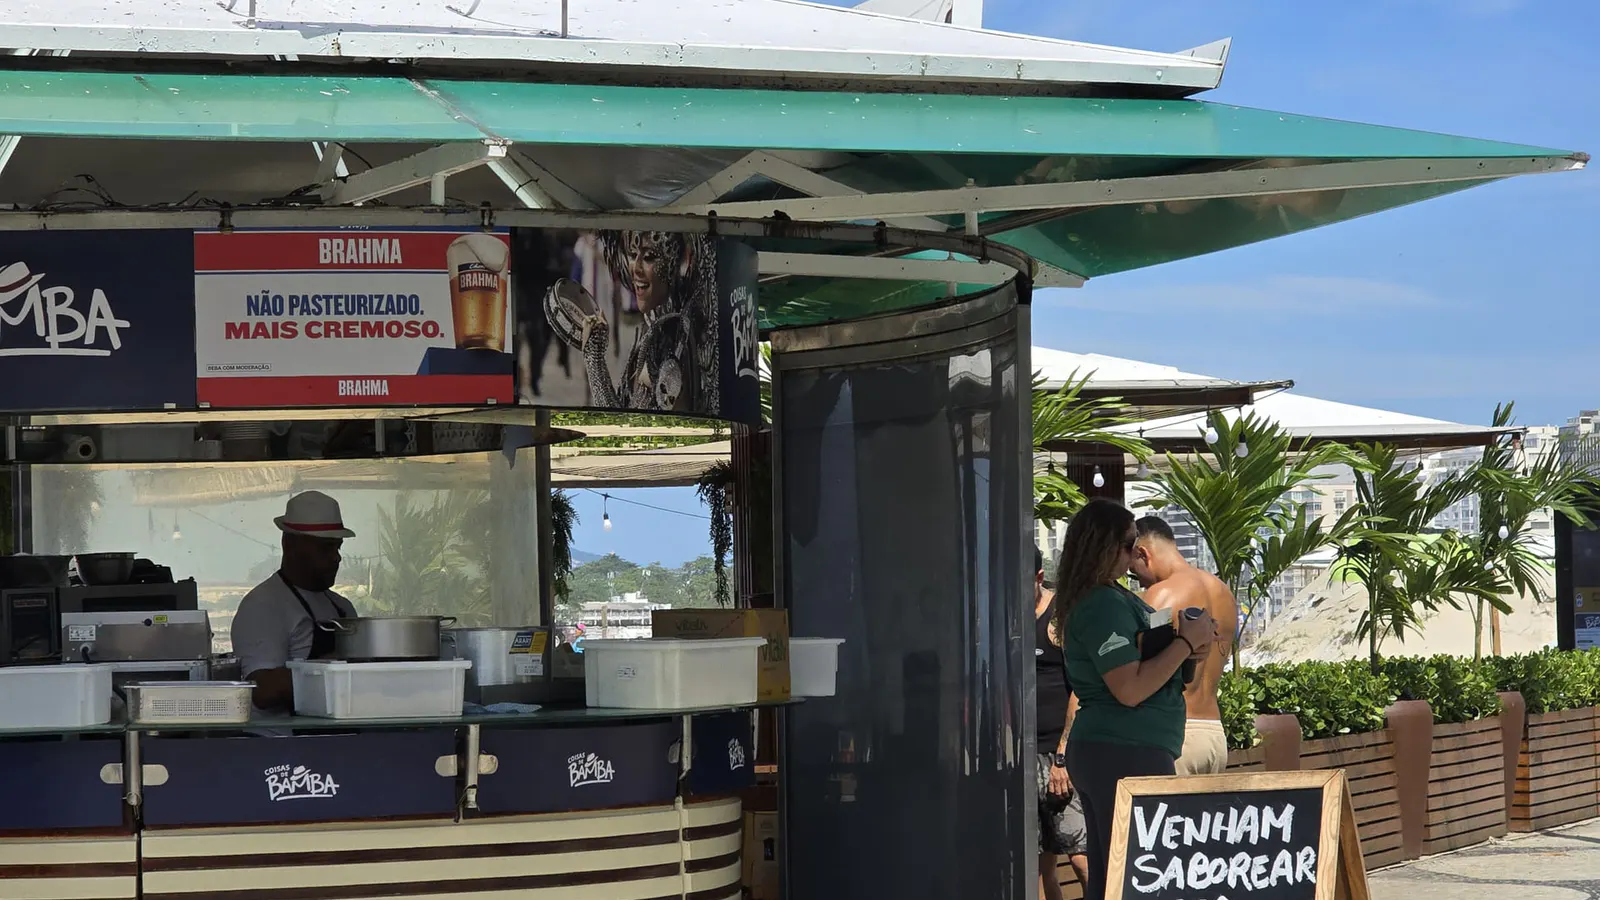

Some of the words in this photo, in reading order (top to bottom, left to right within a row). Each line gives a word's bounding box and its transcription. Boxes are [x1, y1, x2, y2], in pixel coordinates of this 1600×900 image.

[318, 238, 403, 265] BRAHMA
[460, 272, 498, 288] BRAHMA
[246, 290, 284, 316] NÃO
[288, 294, 425, 316] PASTEURIZADO.
[730, 286, 747, 307] COISAS
[225, 321, 299, 340] MAIS
[304, 320, 445, 338] CREMOSO.
[338, 379, 389, 396] BRAHMA
[264, 764, 291, 776] COISAS
[568, 760, 615, 787] BAMBA
[265, 773, 340, 801] BAMBA
[1133, 802, 1296, 851] VENHAM
[1131, 845, 1317, 893] SABOREAR
